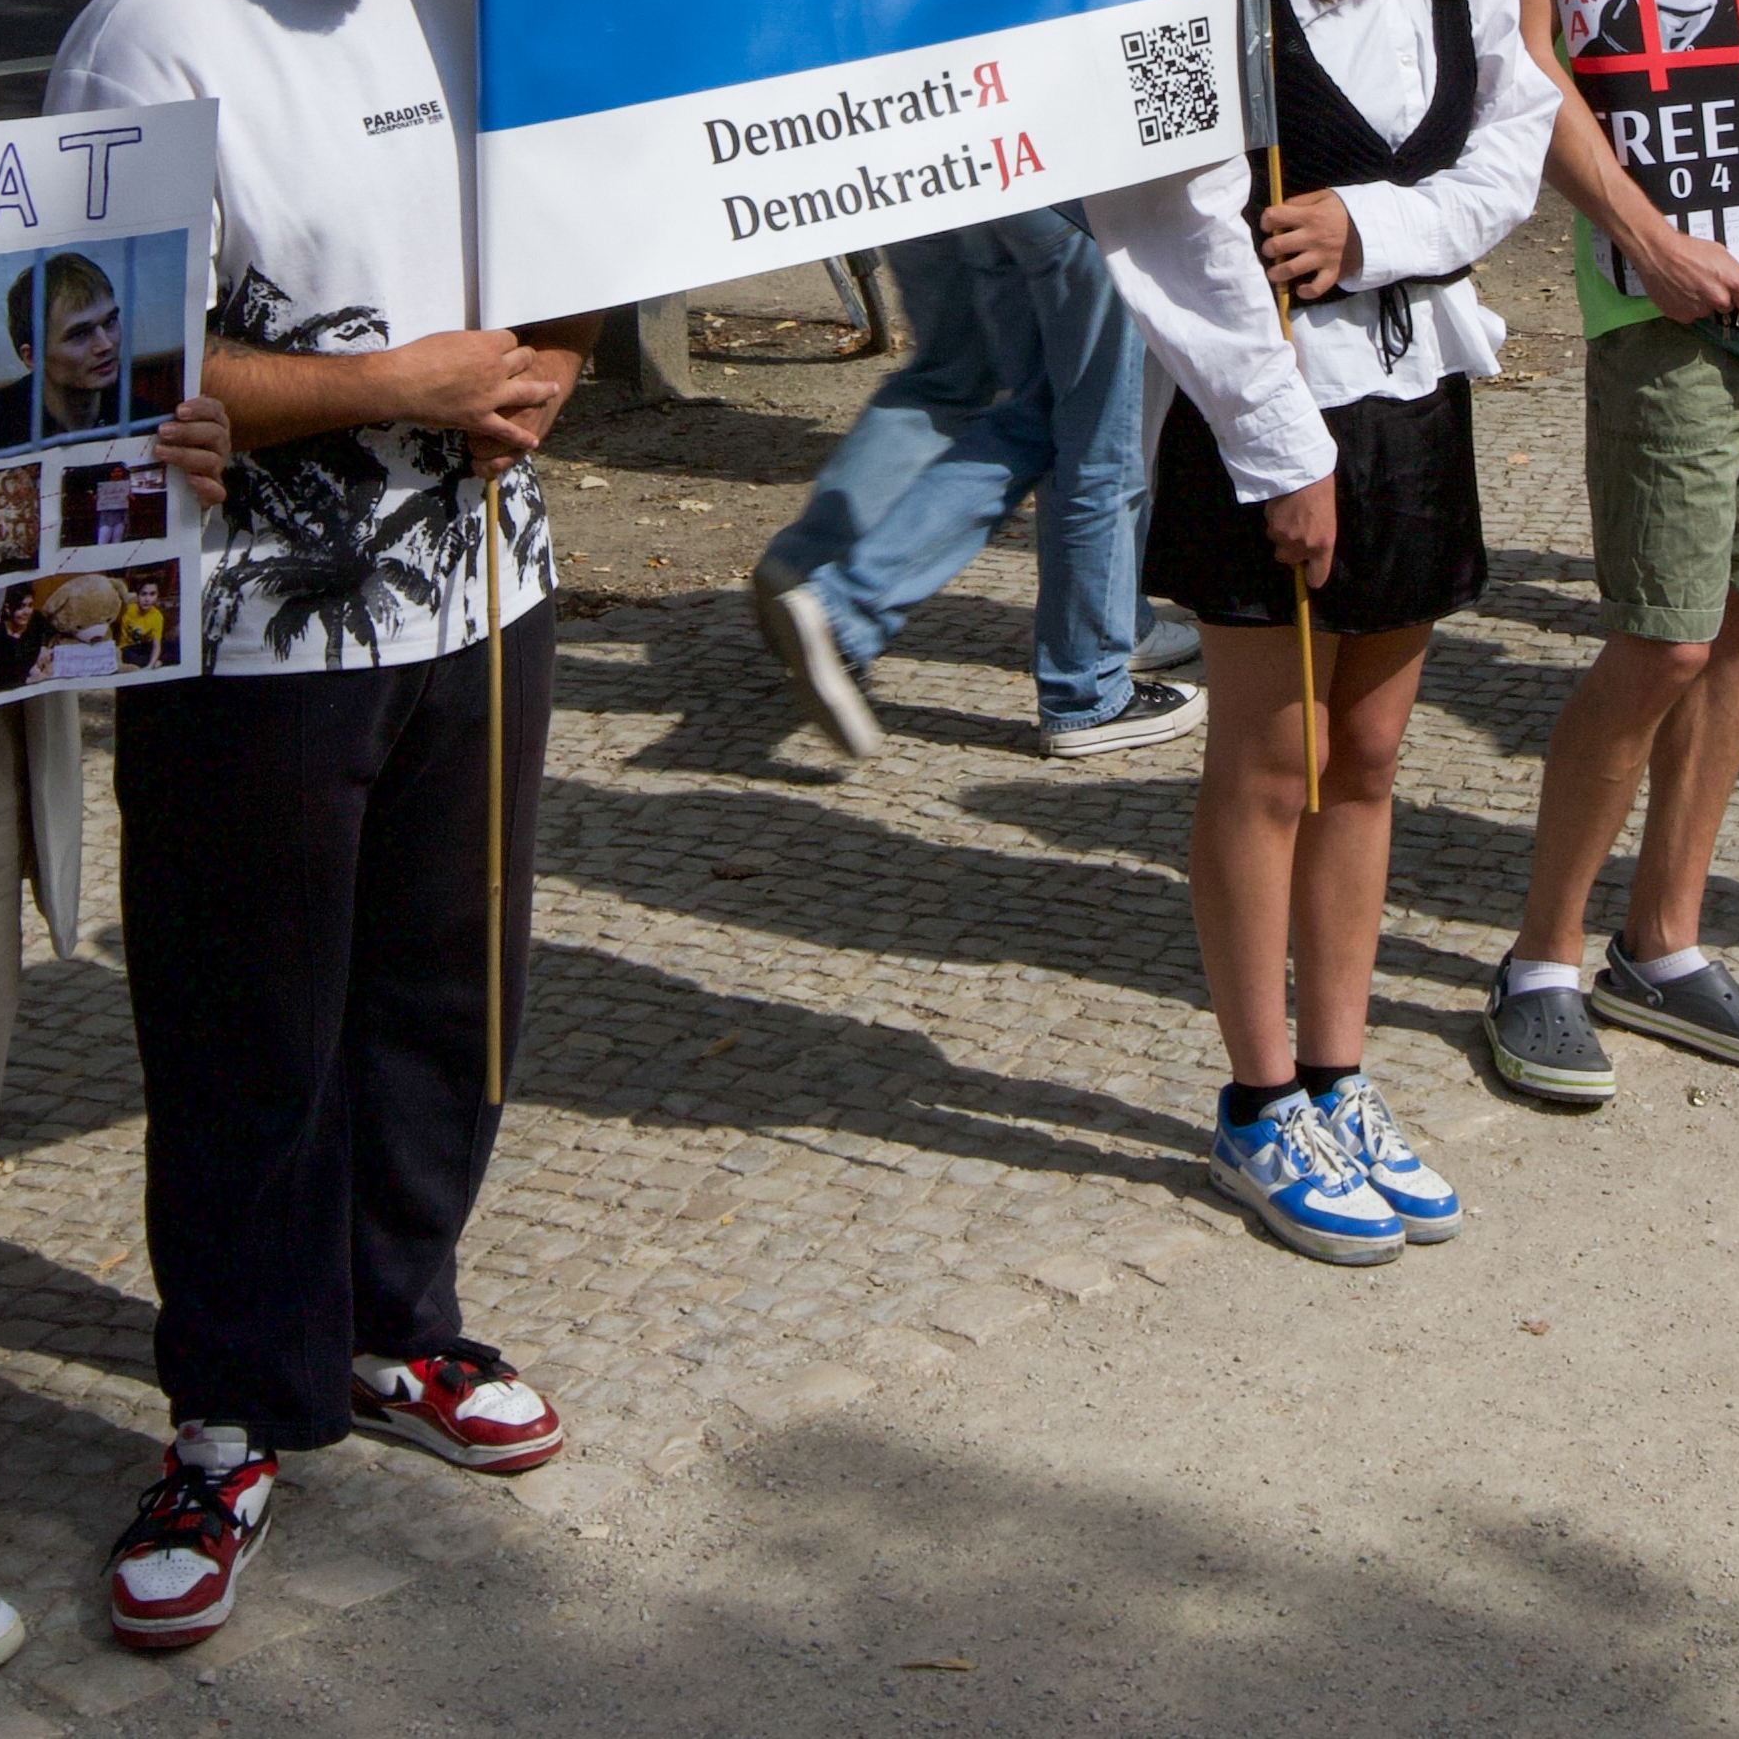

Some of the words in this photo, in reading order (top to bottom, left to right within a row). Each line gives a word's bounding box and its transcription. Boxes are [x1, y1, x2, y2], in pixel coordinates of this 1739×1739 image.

[362, 100, 442, 130] PARADISE
[703, 60, 1011, 166] Demokrati-Я
[1597, 98, 1739, 167] REE
[720, 131, 1047, 242] Demokrati-JA
